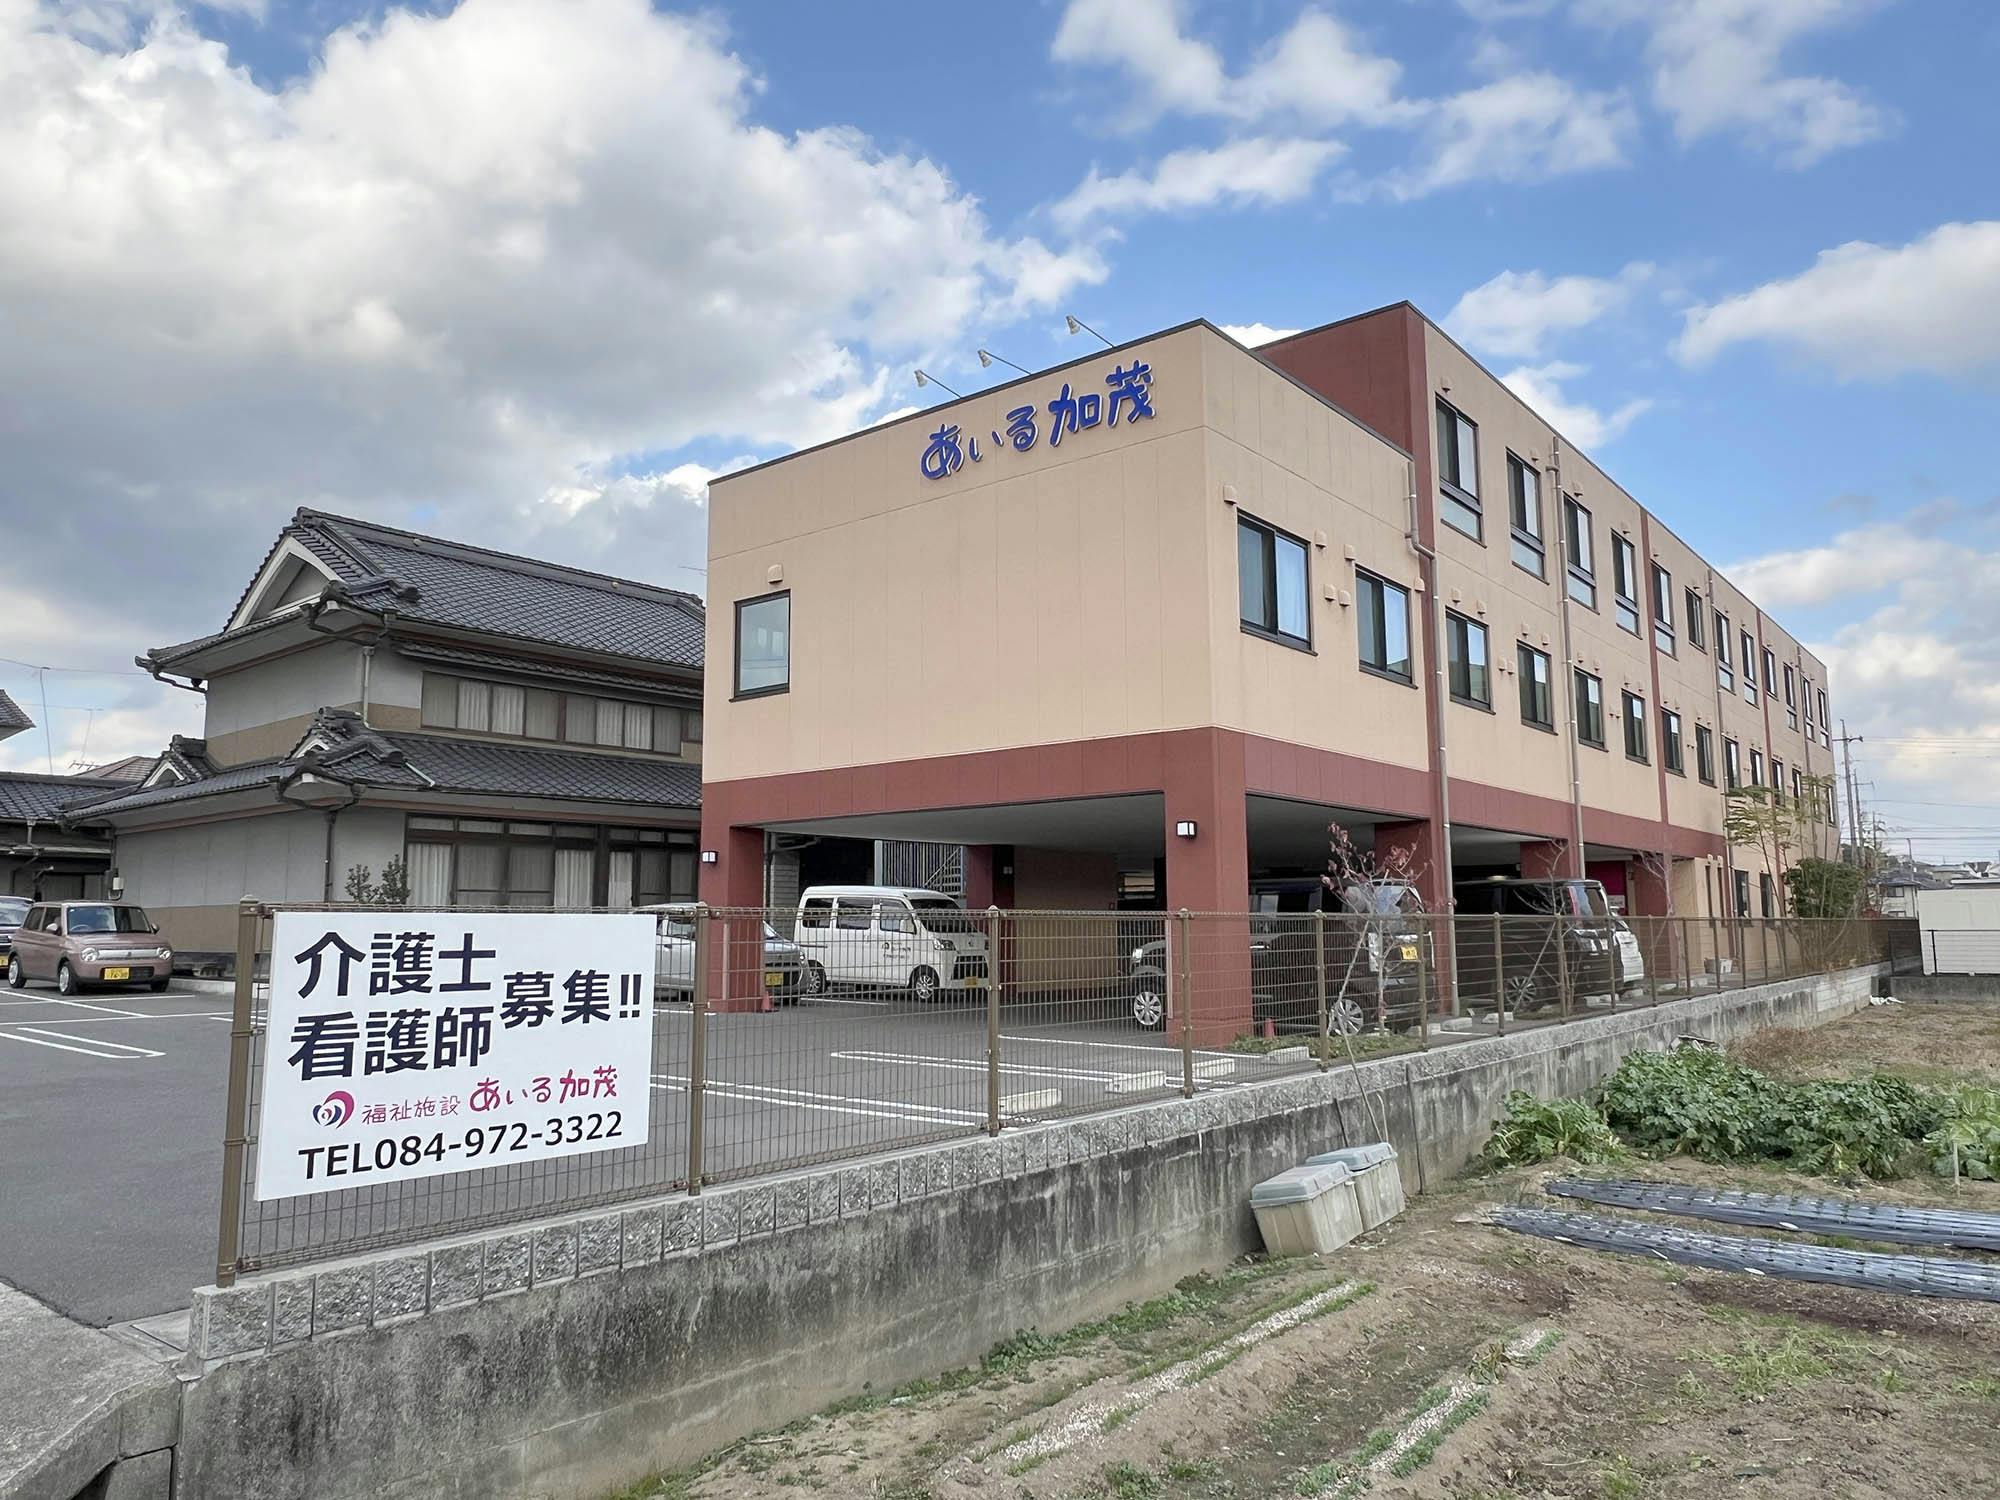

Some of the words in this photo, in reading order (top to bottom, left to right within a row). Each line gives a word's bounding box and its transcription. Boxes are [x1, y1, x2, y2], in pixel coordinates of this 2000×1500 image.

[921, 359, 1155, 479] あいる加茂
[295, 931, 497, 999] 介護士
[287, 1006, 494, 1081] 看護師
[361, 1095, 461, 1125] 福祉施設
[469, 1065, 618, 1112] あいる加茂
[298, 1111, 623, 1180] TEL084-972-3322
